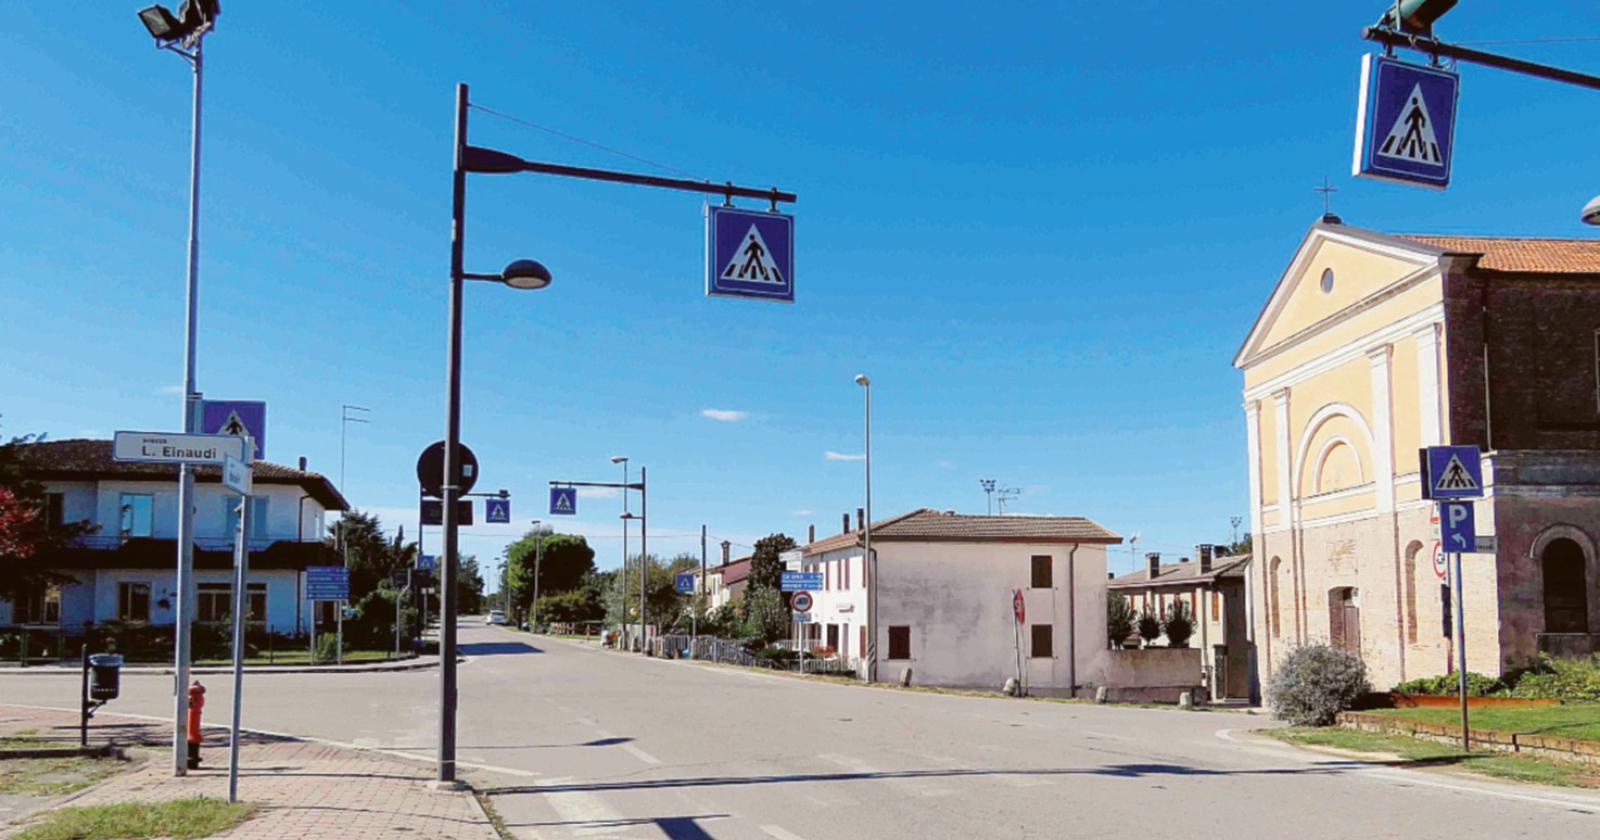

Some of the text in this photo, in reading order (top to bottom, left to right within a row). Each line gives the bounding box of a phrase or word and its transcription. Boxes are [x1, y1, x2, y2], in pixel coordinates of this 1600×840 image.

[142, 445, 217, 459] L. Einaudi
[1449, 504, 1468, 529] P
